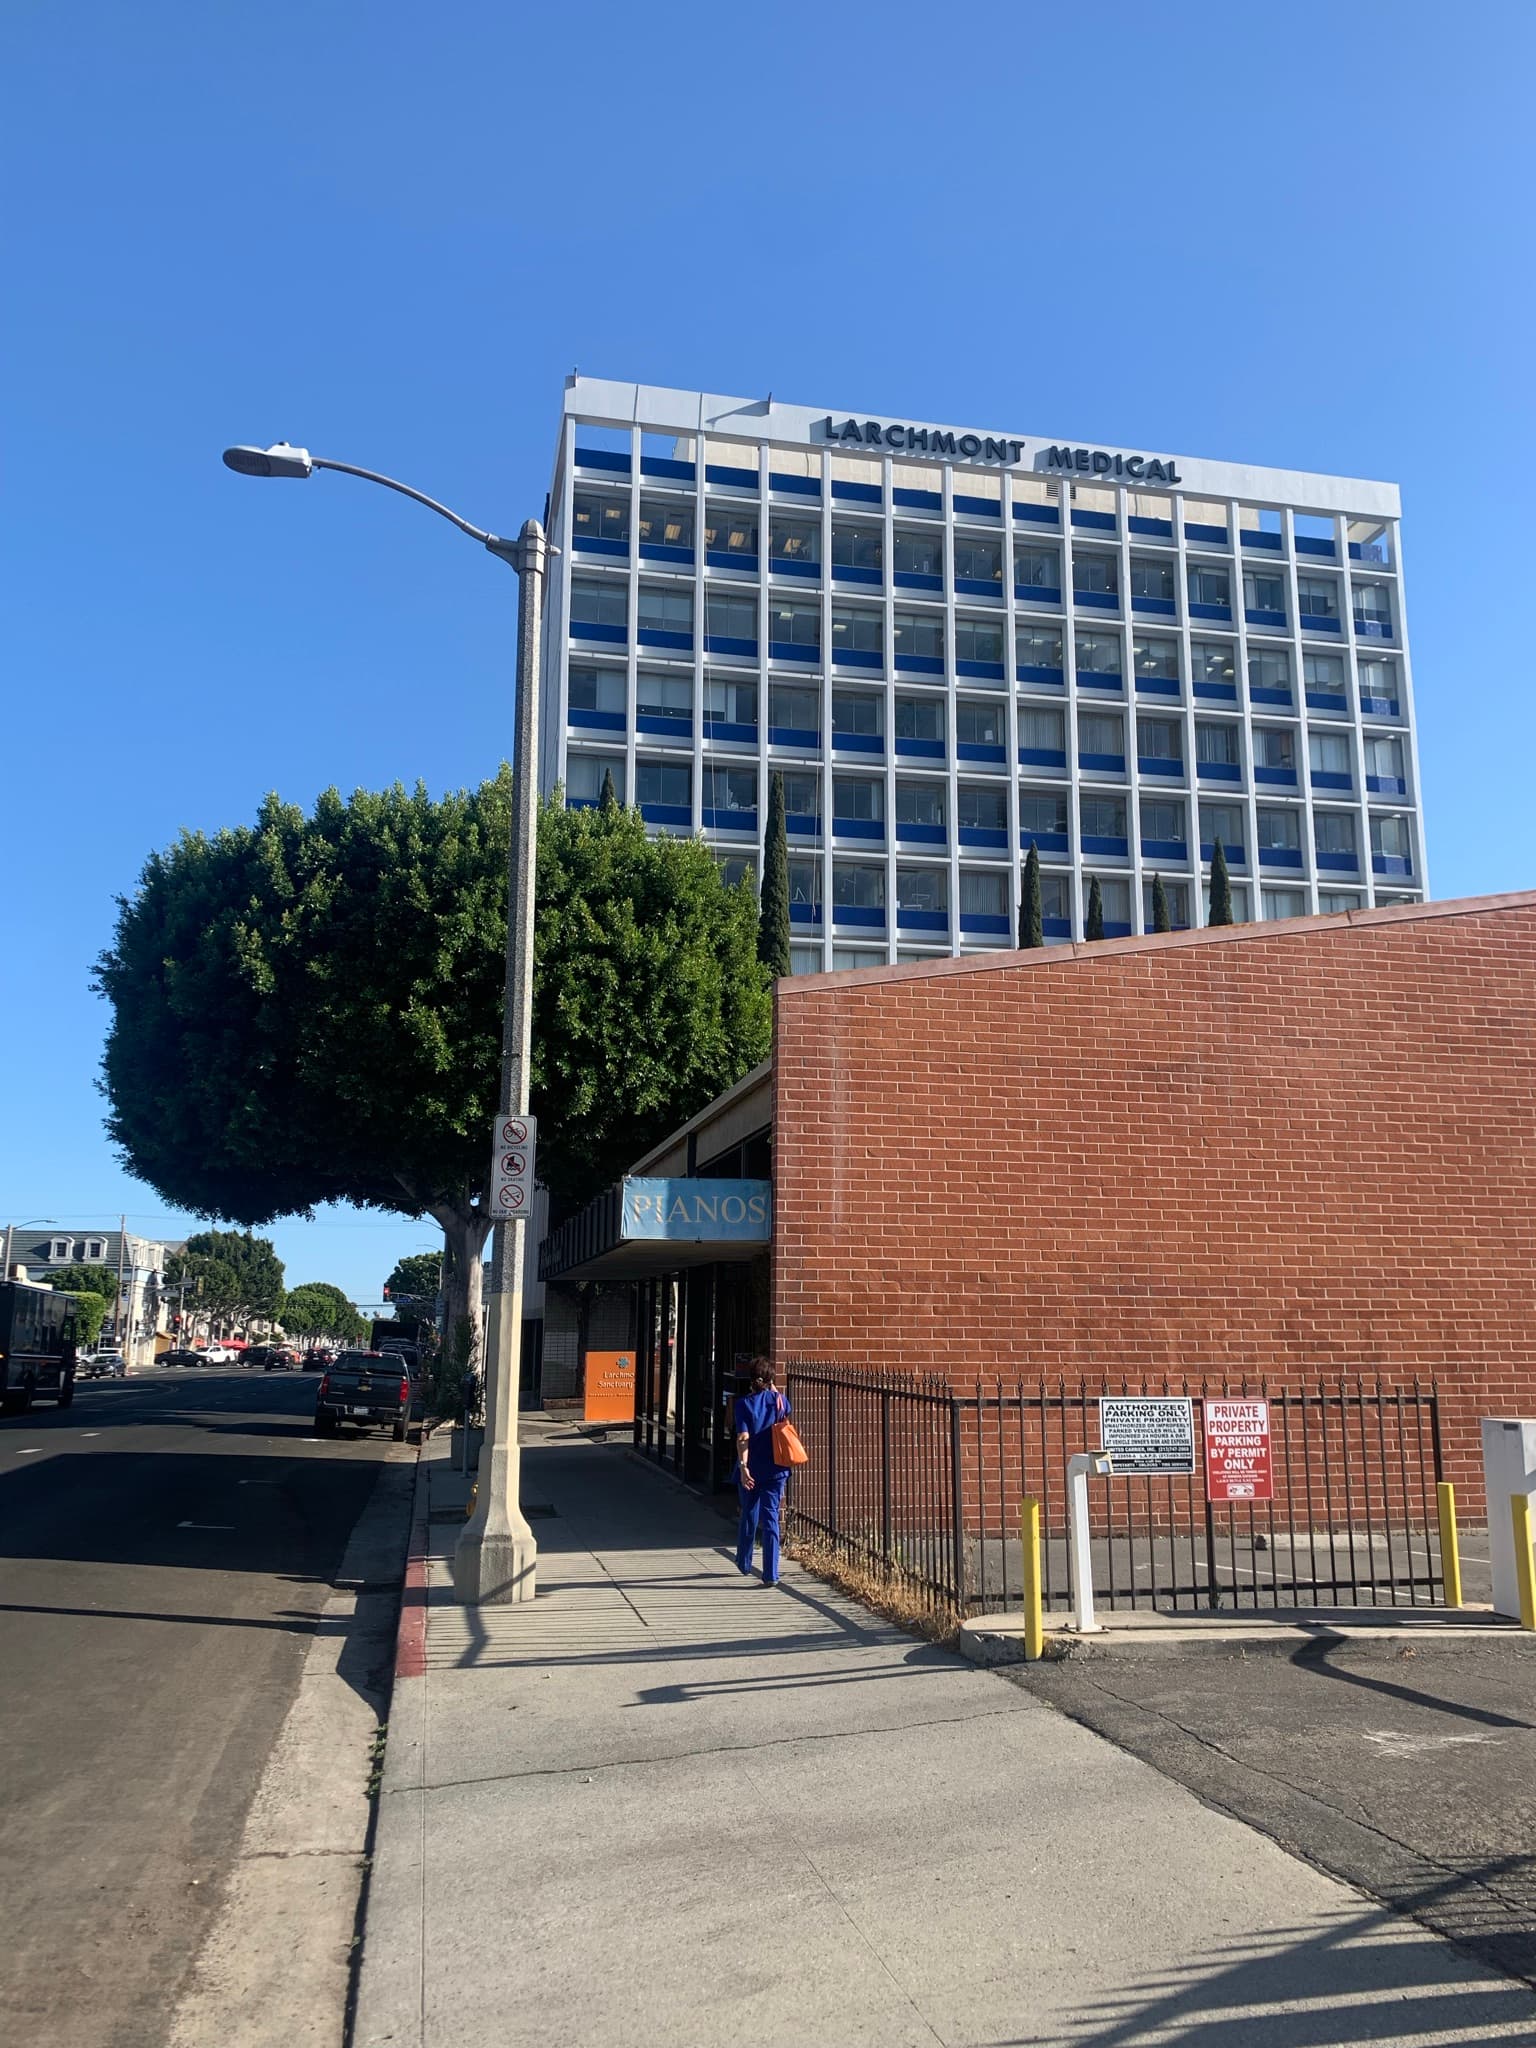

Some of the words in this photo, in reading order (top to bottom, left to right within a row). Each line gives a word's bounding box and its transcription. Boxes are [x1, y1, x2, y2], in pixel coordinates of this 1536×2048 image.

[826, 416, 1025, 462] LARCHMONT
[1048, 445, 1182, 482] MEDICAL
[632, 1194, 767, 1224] PIANOS
[1214, 1405, 1259, 1418] PRIVATE
[1209, 1420, 1265, 1432] PROPERTY
[1215, 1436, 1262, 1446] PARKING
[1210, 1448, 1225, 1458] BY
[1227, 1447, 1268, 1458] PERMIT
[1223, 1459, 1255, 1470] ONLY
